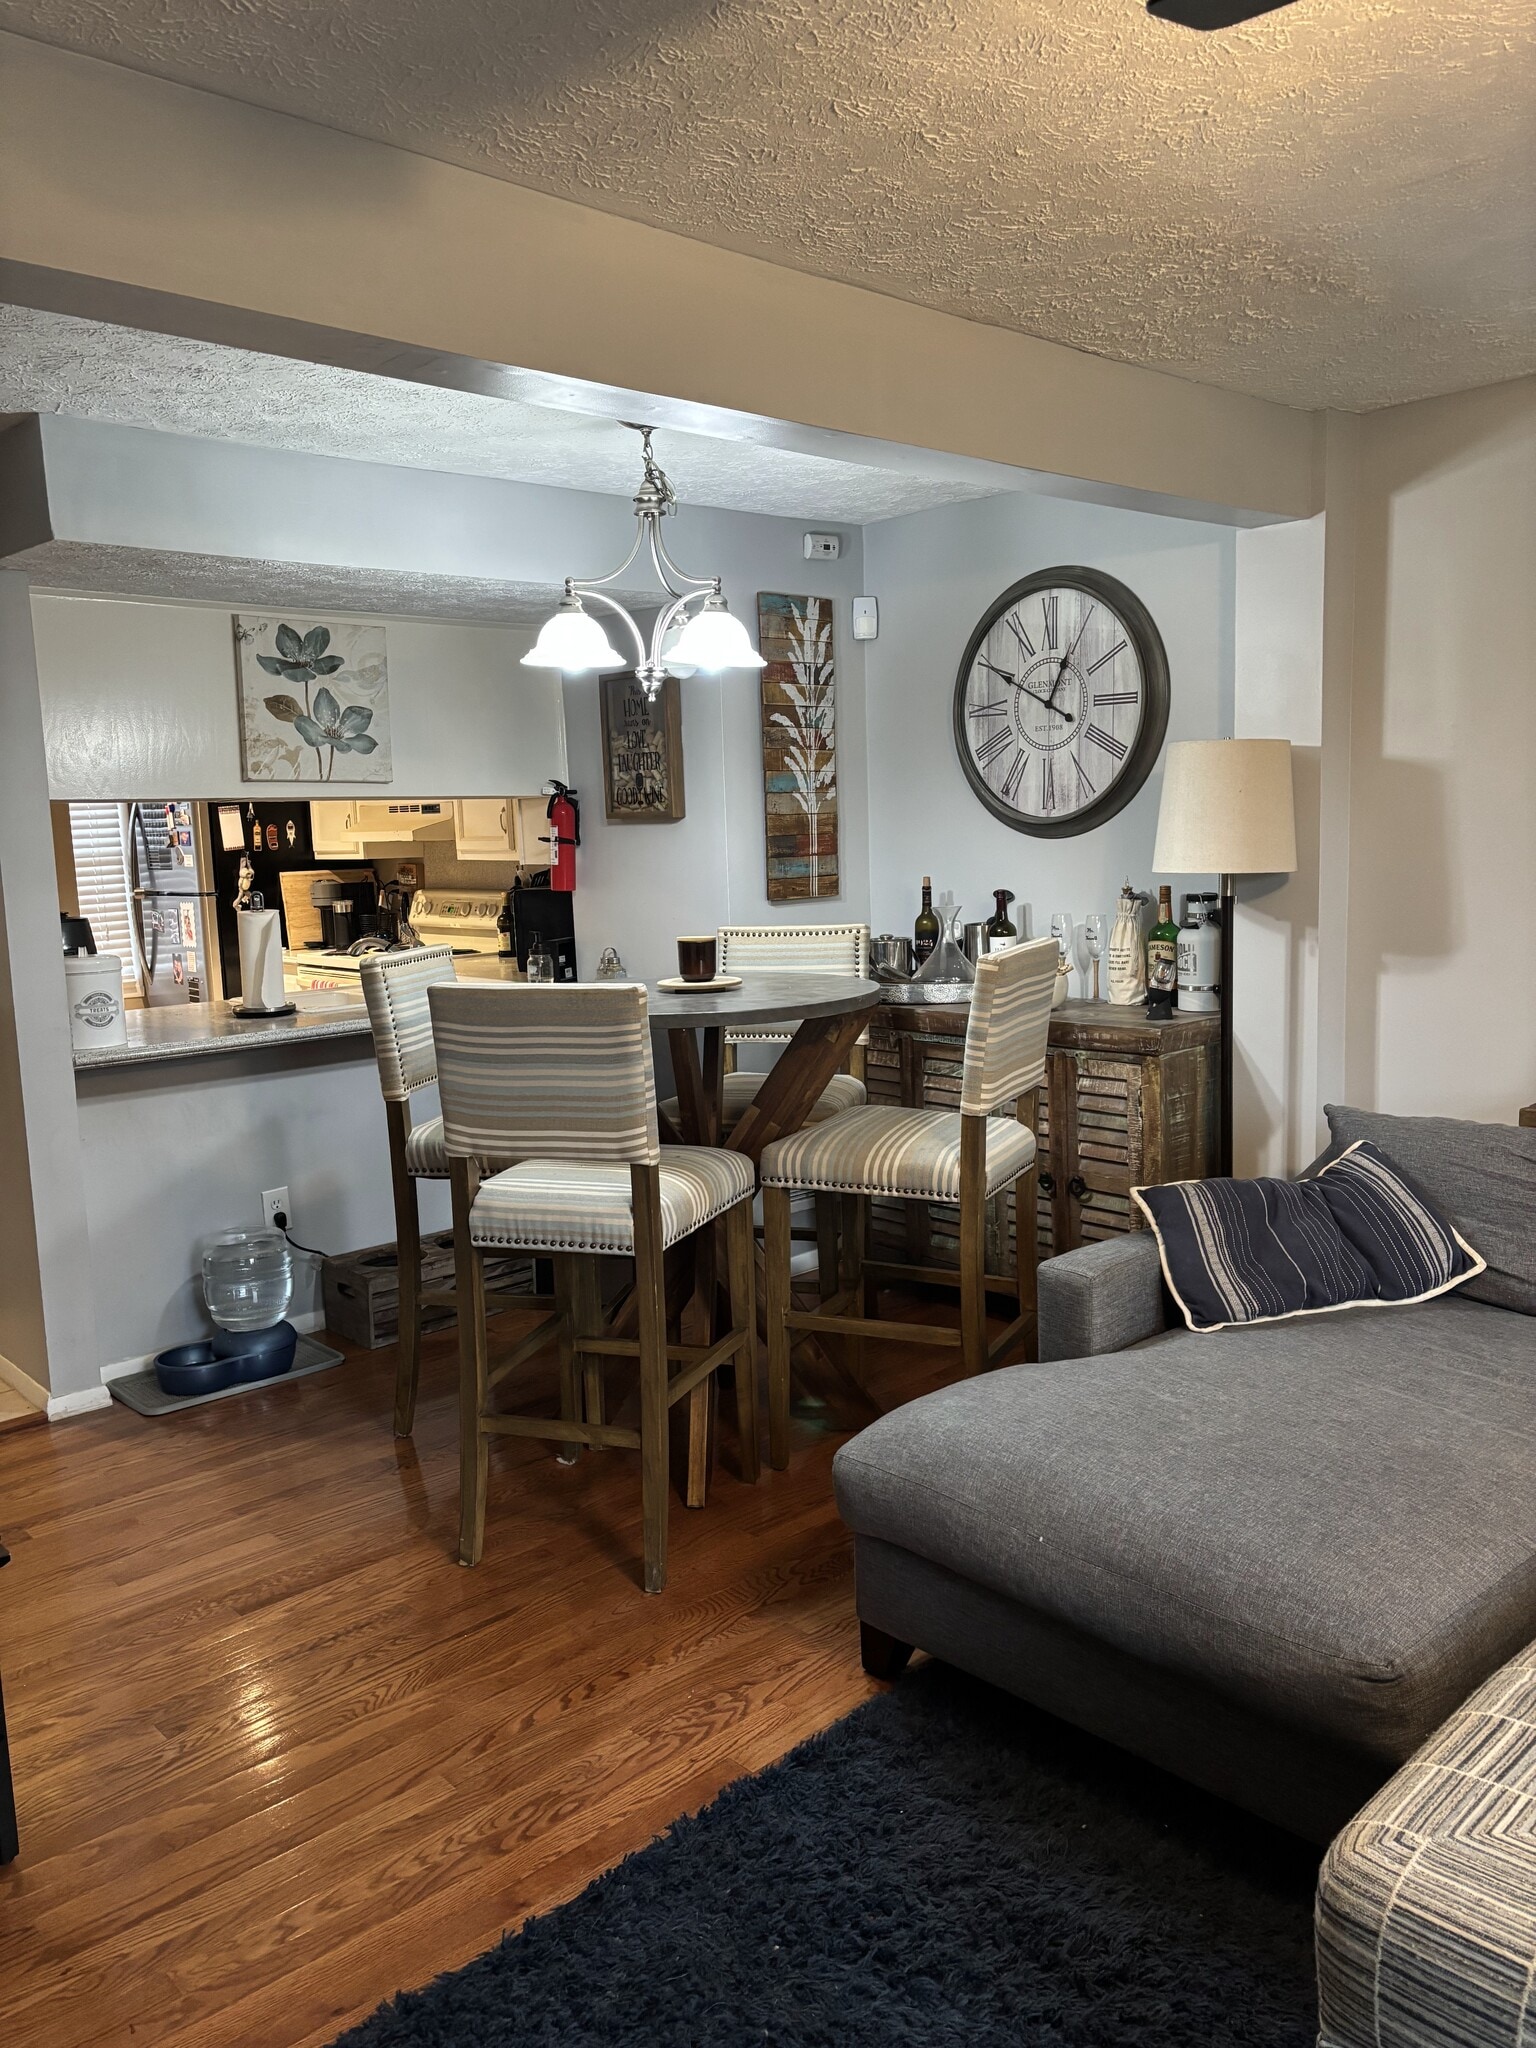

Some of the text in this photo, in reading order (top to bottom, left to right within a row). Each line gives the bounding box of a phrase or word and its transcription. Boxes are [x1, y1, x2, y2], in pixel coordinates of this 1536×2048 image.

[1041, 596, 1059, 651] XII
[1005, 611, 1036, 663] XI
[623, 696, 650, 717] HOME
[1093, 690, 1139, 707] III
[626, 729, 647, 750] LOVE
[617, 751, 661, 772] LAUGHTER
[617, 786, 665, 806] GOOD WINE
[1149, 943, 1175, 953] AMESON
